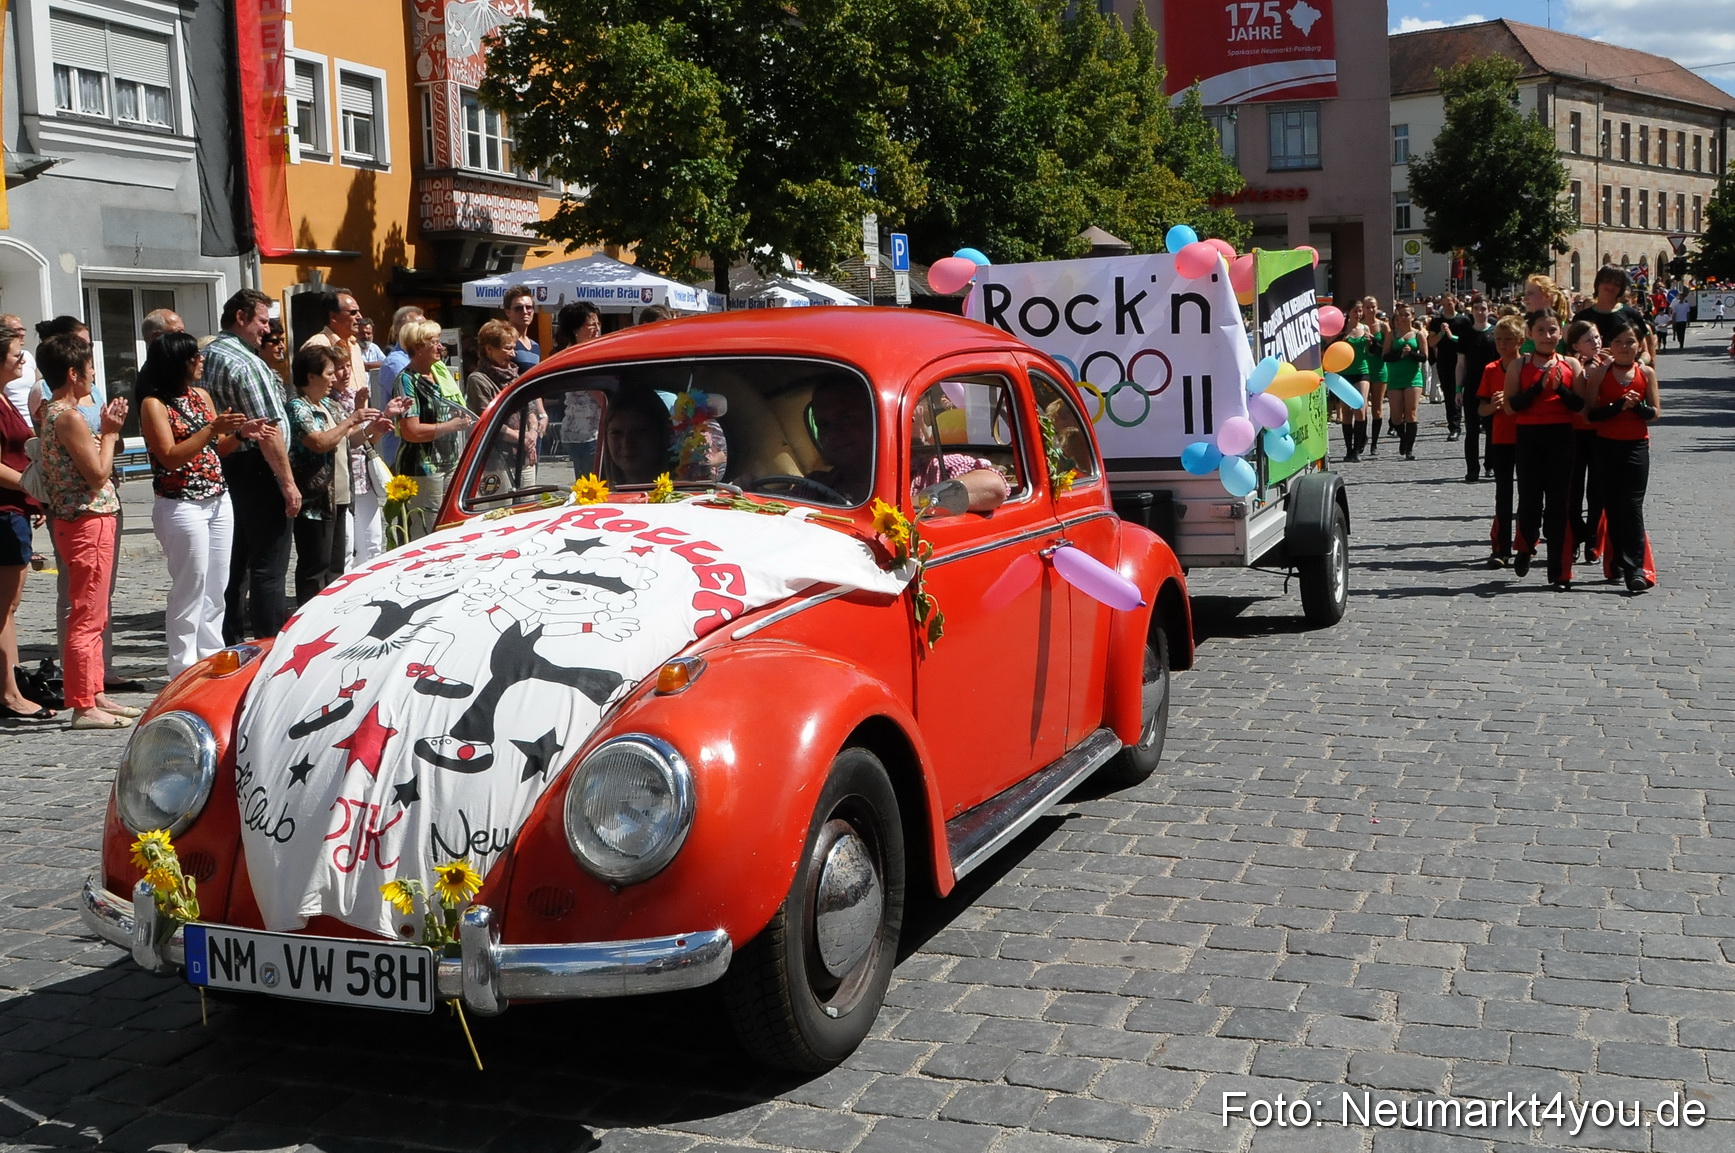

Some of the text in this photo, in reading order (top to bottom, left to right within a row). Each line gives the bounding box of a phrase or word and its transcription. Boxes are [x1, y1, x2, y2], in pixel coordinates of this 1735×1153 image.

[1225, 1, 1282, 26] 175
[1227, 25, 1282, 41] JAHRE
[1227, 45, 1322, 56] Sparkasse Neumarkt-Parsberg
[895, 238, 905, 266] P
[576, 286, 640, 299] Winkler Bräu
[192, 961, 200, 974] D
[208, 935, 426, 1003] NM VW 58H
